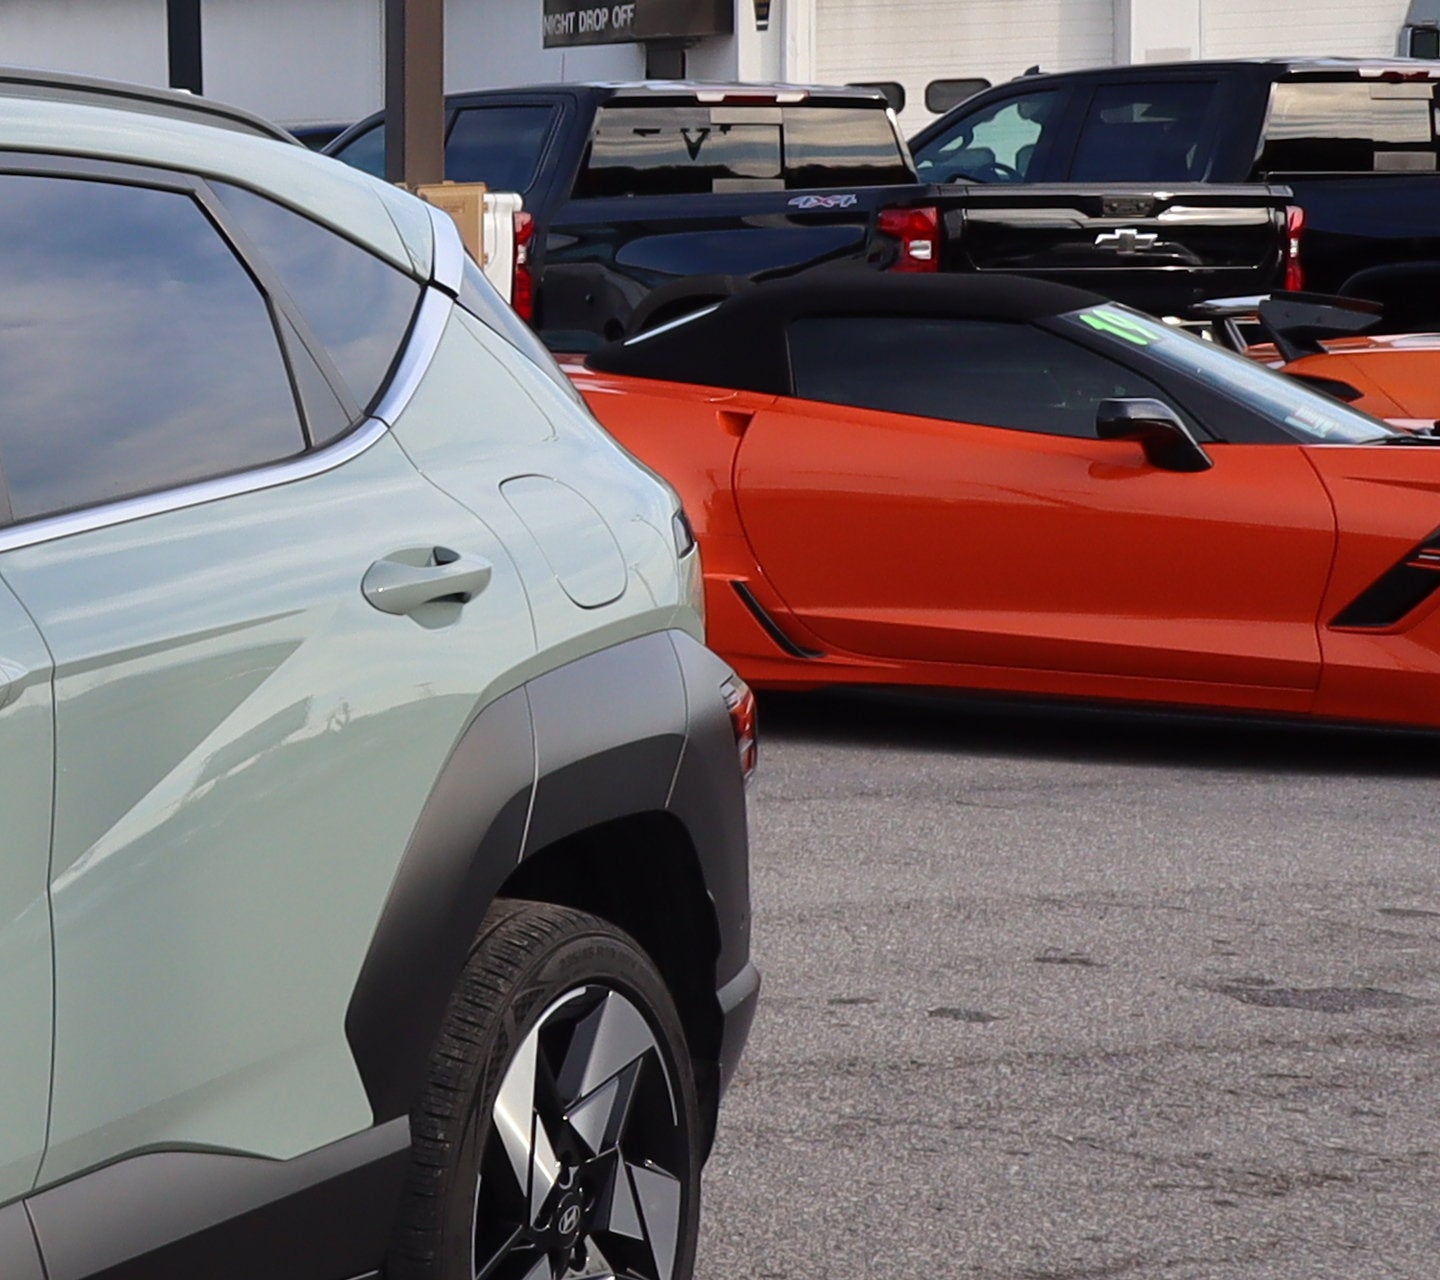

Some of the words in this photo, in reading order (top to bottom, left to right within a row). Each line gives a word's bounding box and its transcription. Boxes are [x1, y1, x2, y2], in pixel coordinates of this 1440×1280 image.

[543, 11, 576, 36] NIGHT
[578, 7, 609, 33] DROP
[612, 3, 635, 29] OFF
